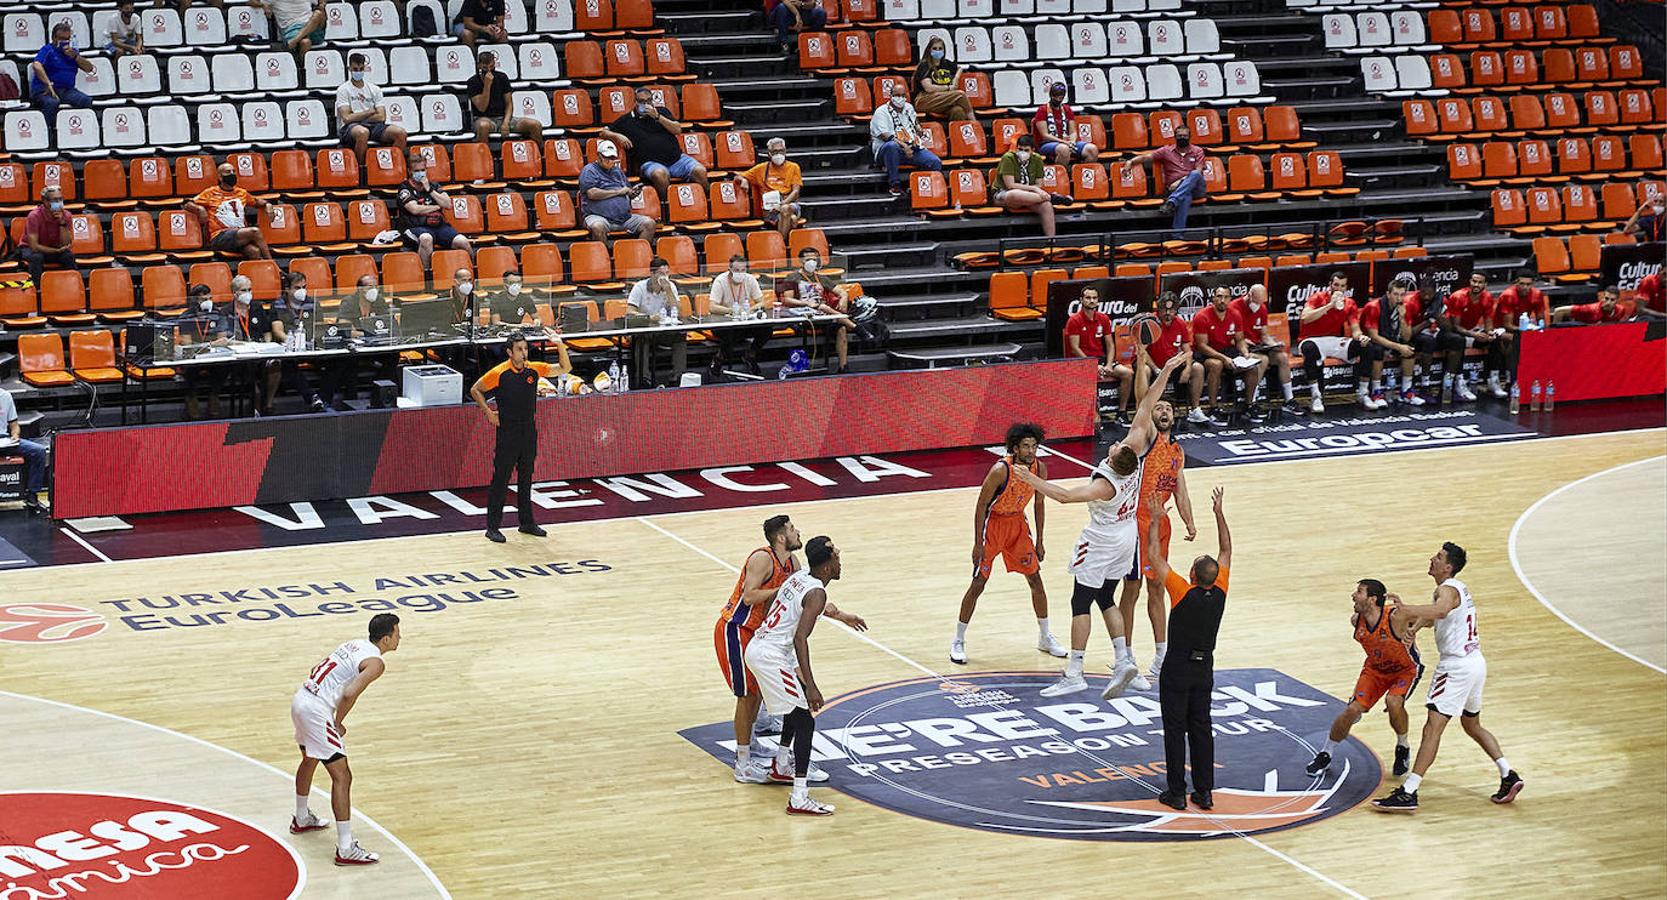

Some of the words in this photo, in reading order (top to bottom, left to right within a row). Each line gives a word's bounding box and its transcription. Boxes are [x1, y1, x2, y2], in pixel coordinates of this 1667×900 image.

[1420, 267, 1459, 281] vencia
[1619, 261, 1662, 279] Cultur
[1207, 282, 1248, 297] vncia
[1287, 284, 1331, 302] Cult
[1068, 300, 1124, 317] Cura
[1331, 415, 1411, 427] Valencia
[1409, 411, 1475, 421] Basket
[1218, 424, 1483, 456] Europcar
[234, 455, 932, 531] VALENCIA
[97, 580, 357, 612] TURKISH
[373, 558, 613, 592] AIRLINES
[119, 588, 521, 632] EuroLeague
[847, 733, 1149, 777] PRESEASON
[1018, 761, 1225, 788] VALENC
